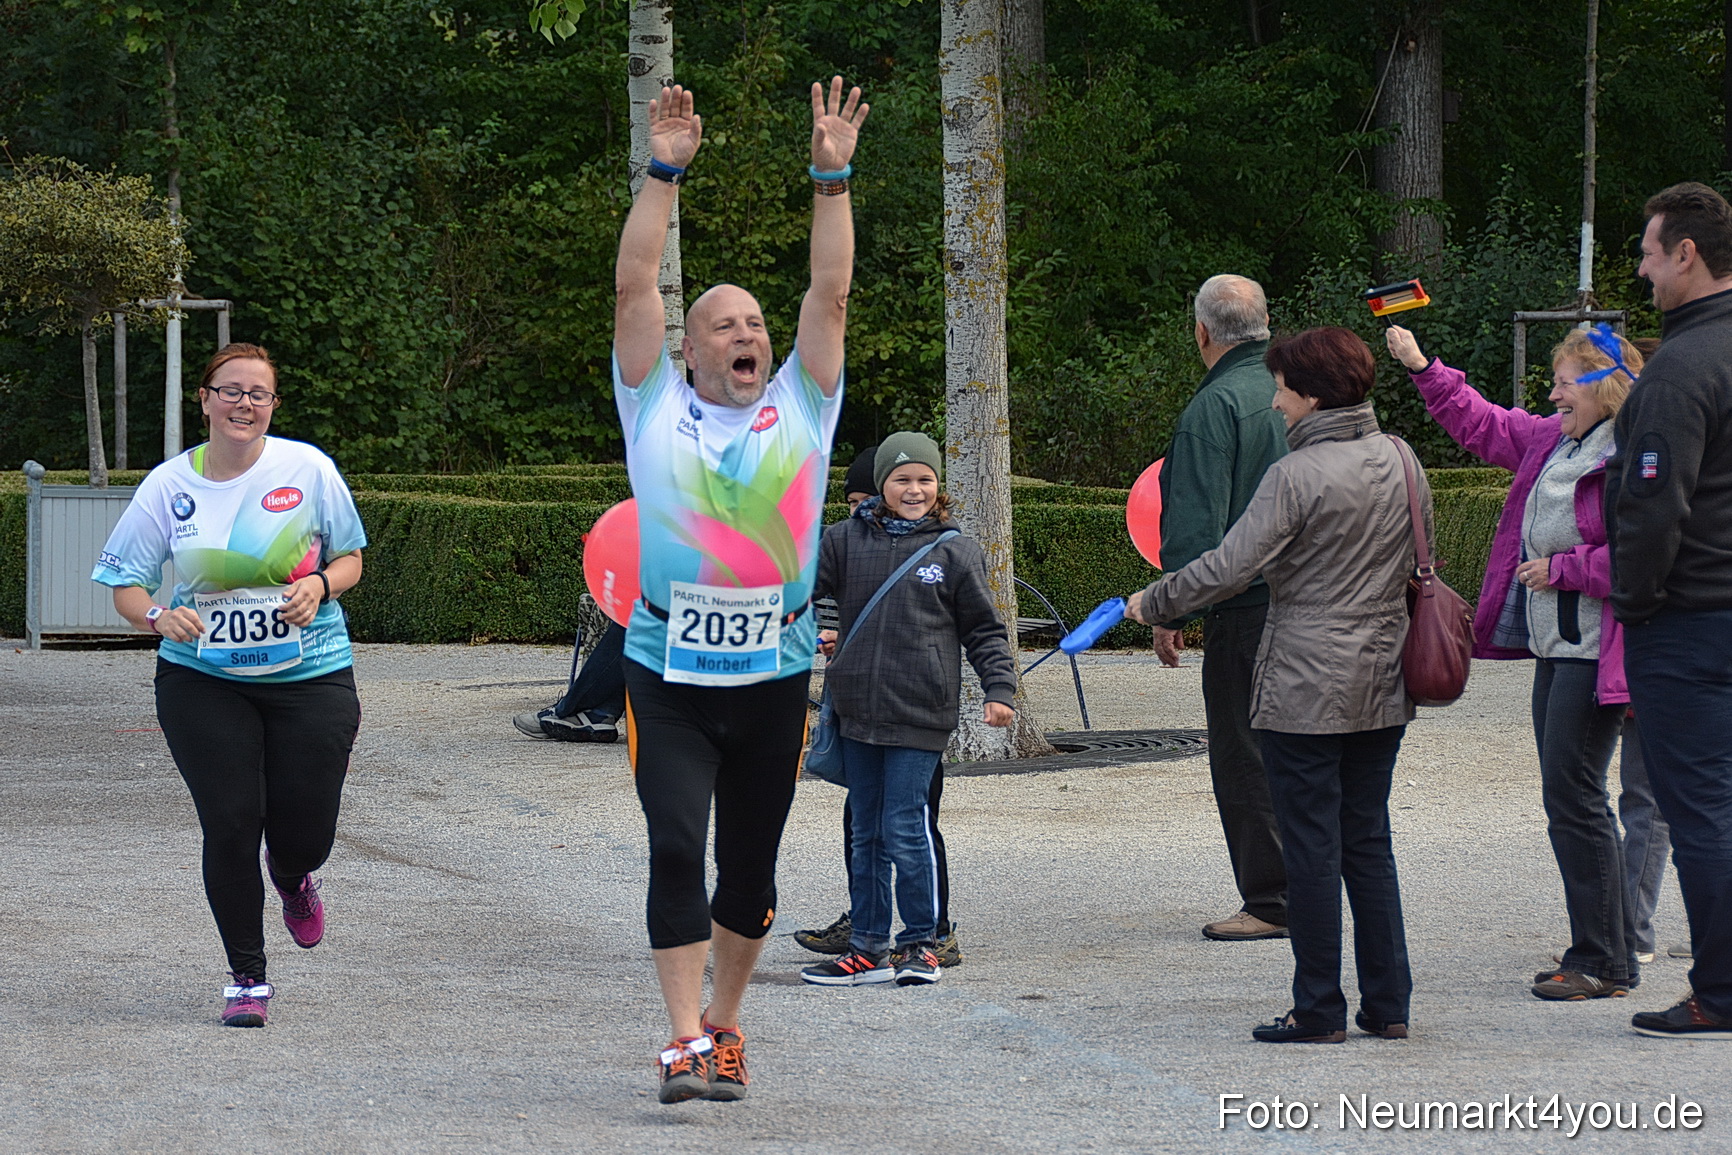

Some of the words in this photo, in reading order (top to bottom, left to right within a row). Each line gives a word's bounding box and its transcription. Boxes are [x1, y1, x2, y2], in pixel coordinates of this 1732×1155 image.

[267, 493, 299, 506] Hervis
[198, 598, 231, 608] PARTL
[232, 596, 278, 605] Neumarkt
[674, 590, 709, 605] PARTL
[711, 597, 765, 607] Neumarkt
[209, 609, 290, 643] 2038
[680, 608, 773, 646] 2037
[230, 650, 269, 666] Sonja
[696, 655, 752, 670] Norbert
